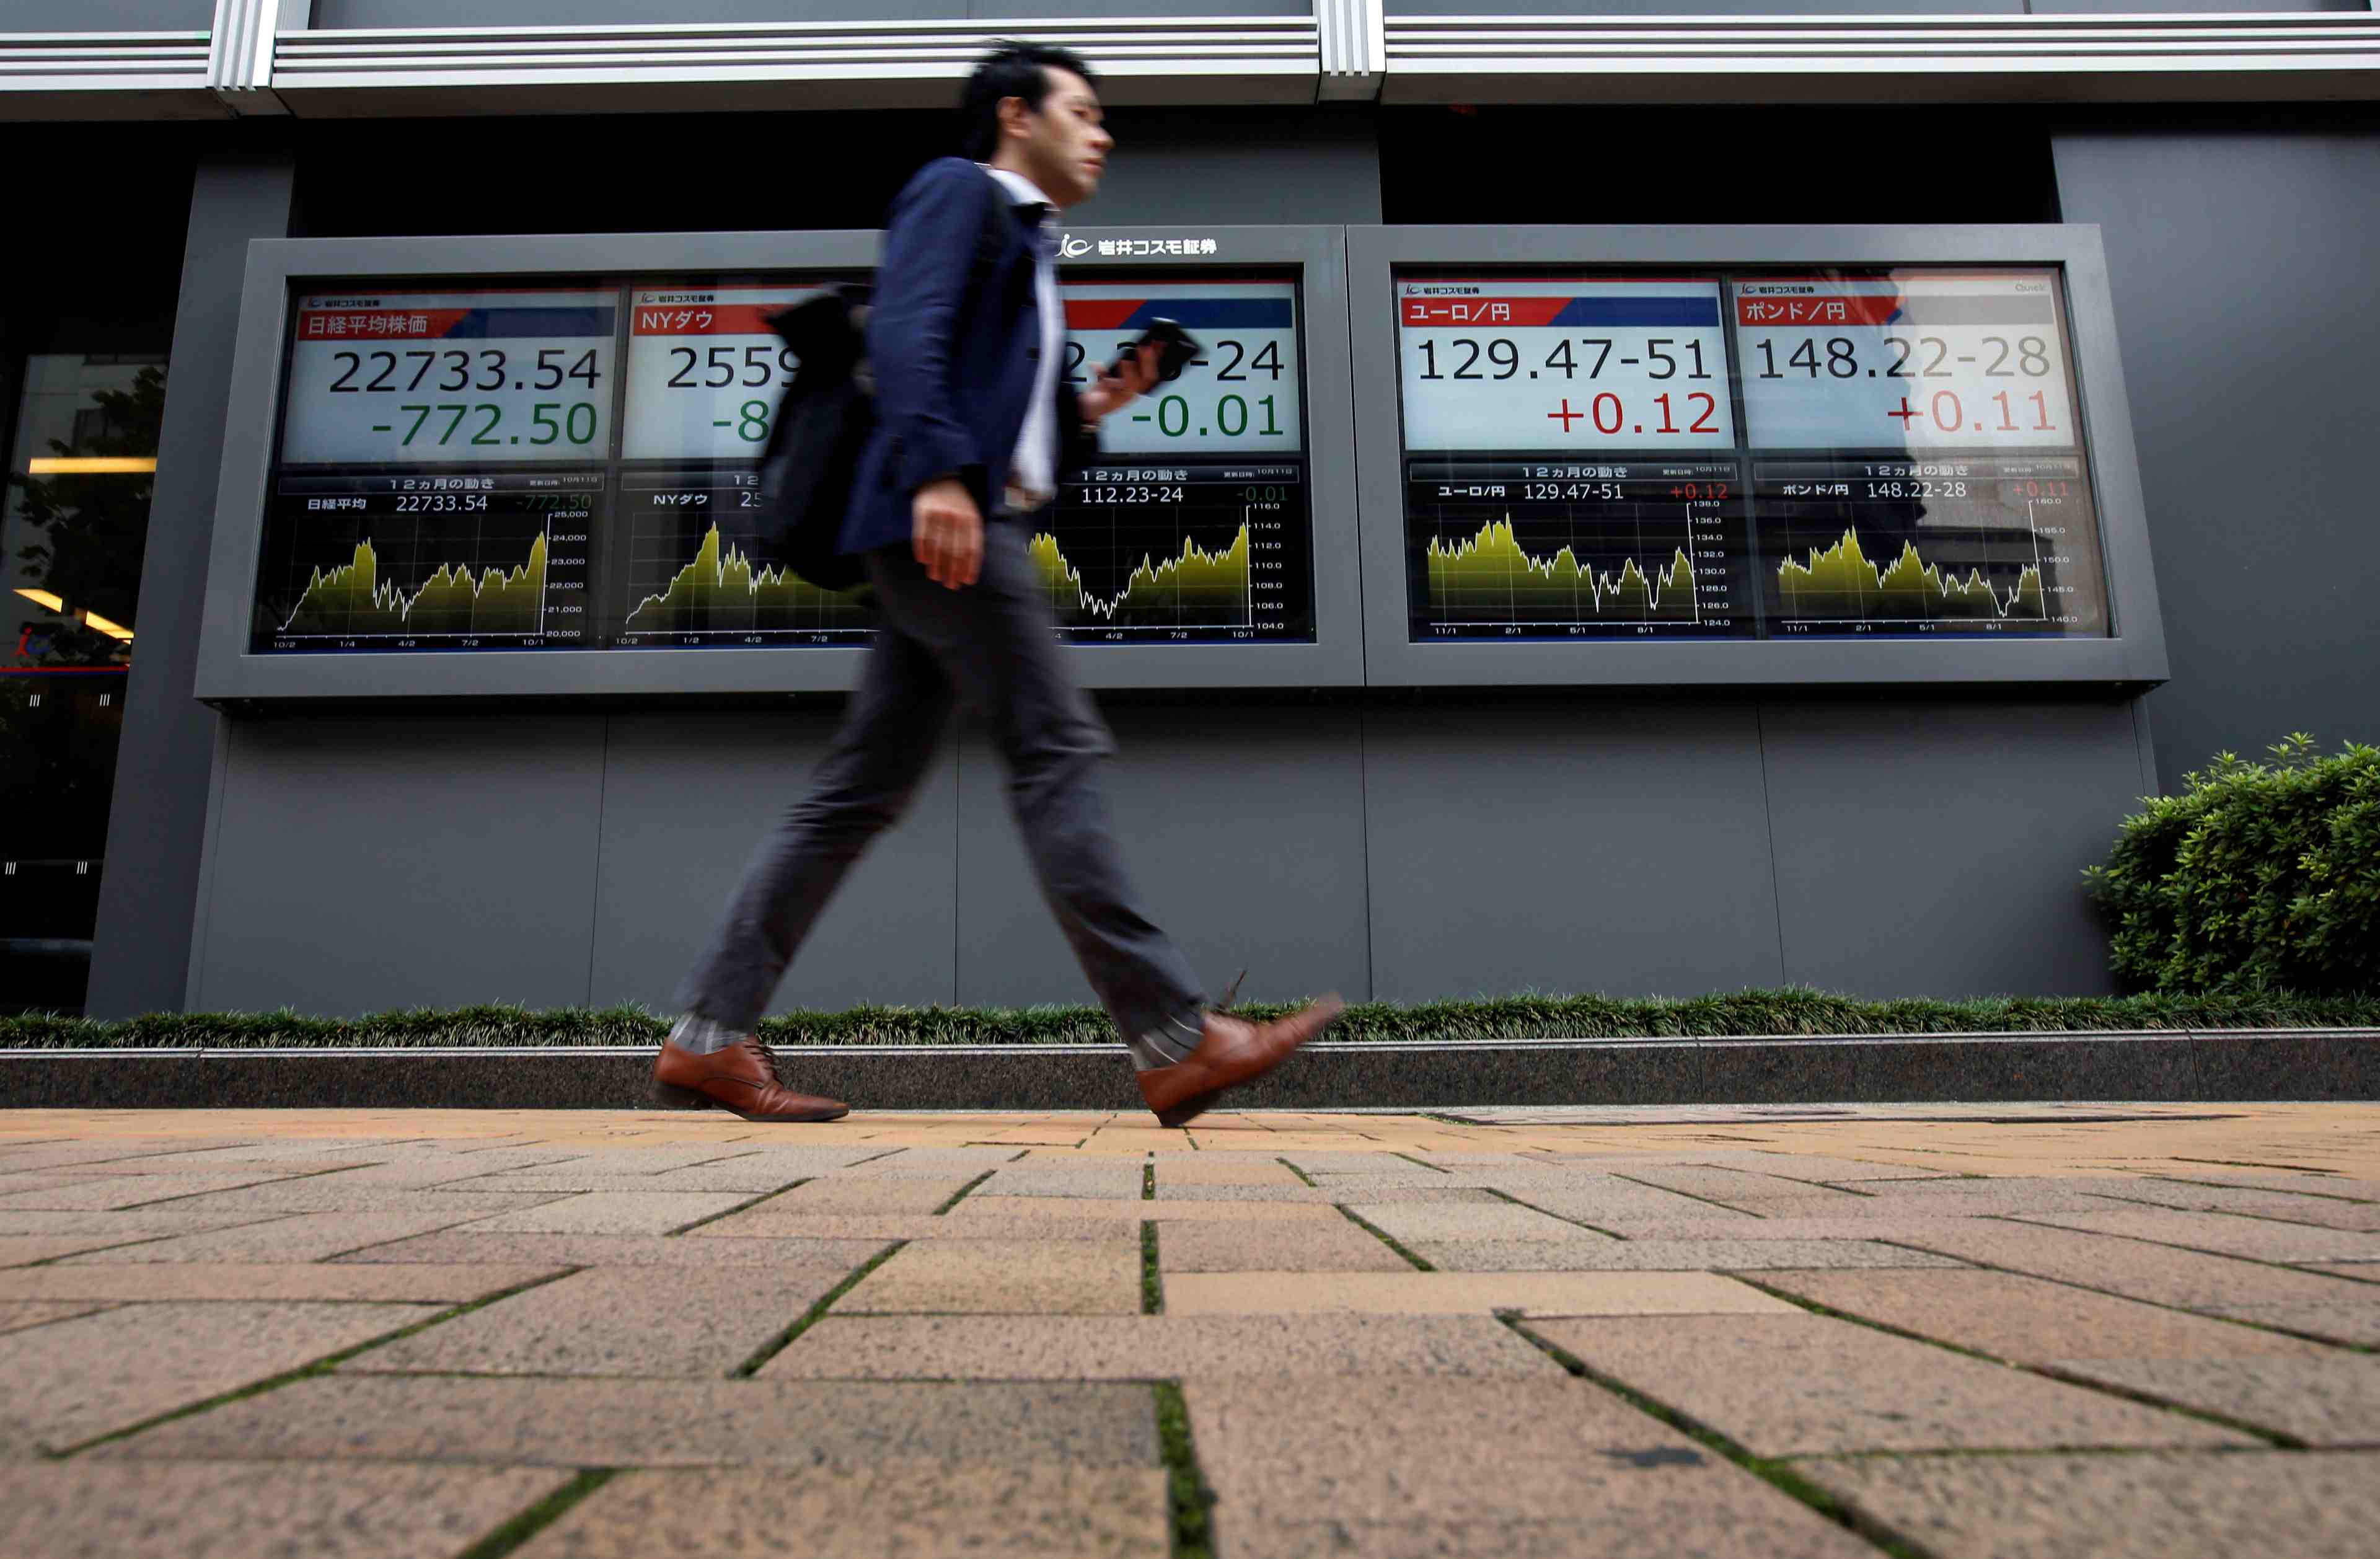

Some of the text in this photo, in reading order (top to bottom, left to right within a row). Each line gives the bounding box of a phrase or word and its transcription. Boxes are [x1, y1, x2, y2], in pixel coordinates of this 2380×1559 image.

[1098, 238, 1218, 255] 岩井コスモ証券
[642, 310, 713, 329] NYダウ
[1410, 302, 1510, 322] ユーロ/円
[1747, 301, 1846, 320] ポンド/円
[308, 315, 428, 334] 日経平均株価
[1418, 338, 1712, 380] 129.47-51
[1756, 337, 2051, 379] 148.22-28
[329, 349, 601, 392] 22733.54
[1132, 394, 1284, 436] -0.01
[1547, 392, 1720, 434] +0.12
[1888, 390, 2056, 431] +0.11
[372, 402, 597, 446] -772.50
[653, 493, 708, 505] NYダウ
[1082, 486, 1288, 503] 112.23-24 -0.01
[1439, 483, 1728, 500] ユーロ/円 129.47-51 +0.12
[1783, 481, 2068, 498] ポンド/円 148.22-28 +0.11
[308, 498, 367, 510] 日経平均
[396, 495, 488, 512] 22733.54
